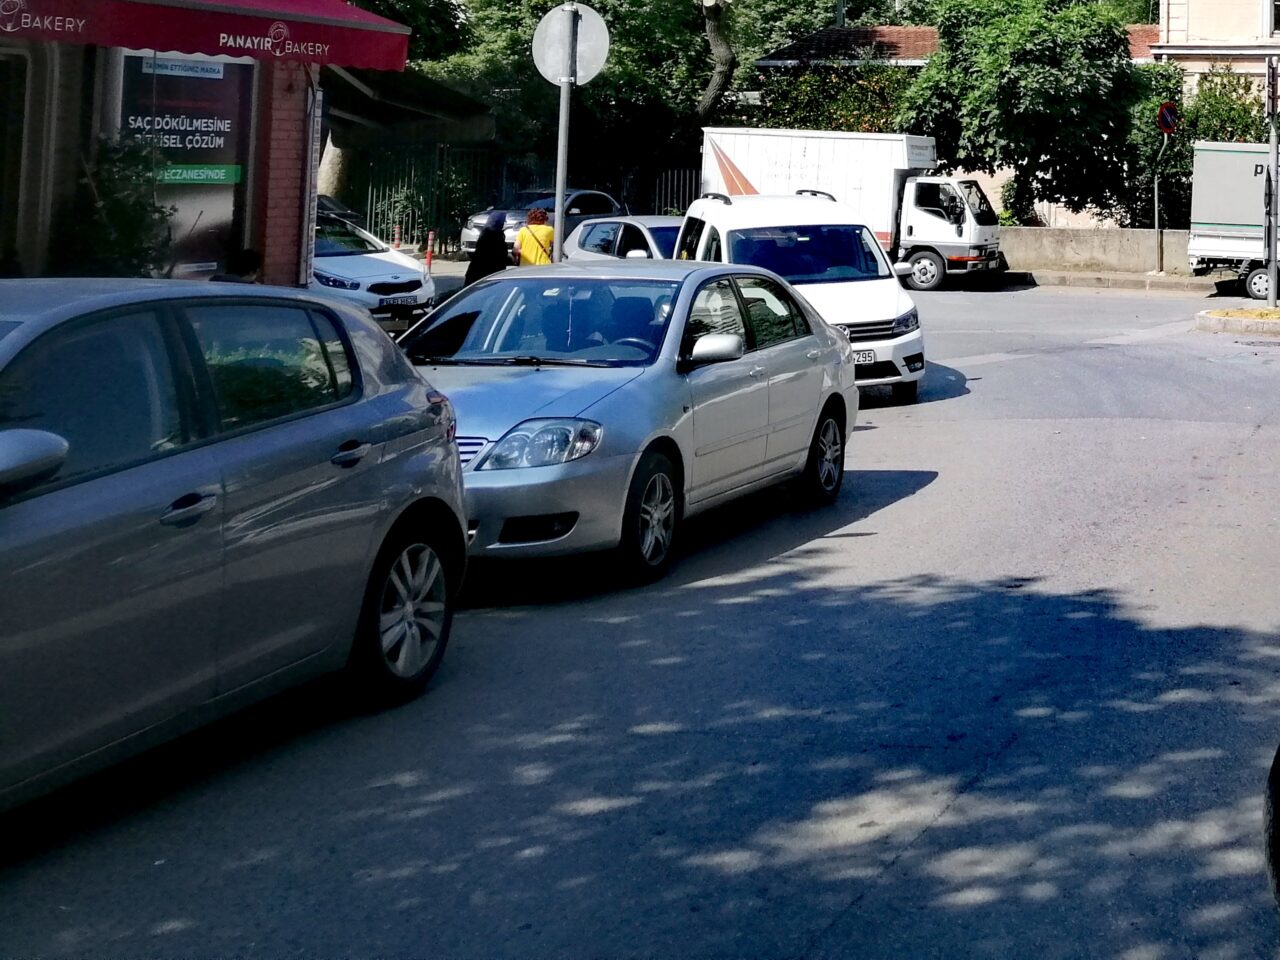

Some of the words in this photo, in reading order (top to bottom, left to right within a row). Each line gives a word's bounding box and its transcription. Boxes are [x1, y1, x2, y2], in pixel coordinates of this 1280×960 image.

[21, 13, 86, 32] BAKERY
[219, 33, 272, 51] PANAYIR
[285, 40, 330, 56] BAKERY
[128, 115, 152, 131] SAÇ
[154, 114, 232, 132] DÖKÜLMESİNE
[185, 133, 225, 150] ÇÖZÜM
[856, 352, 873, 363] 295
